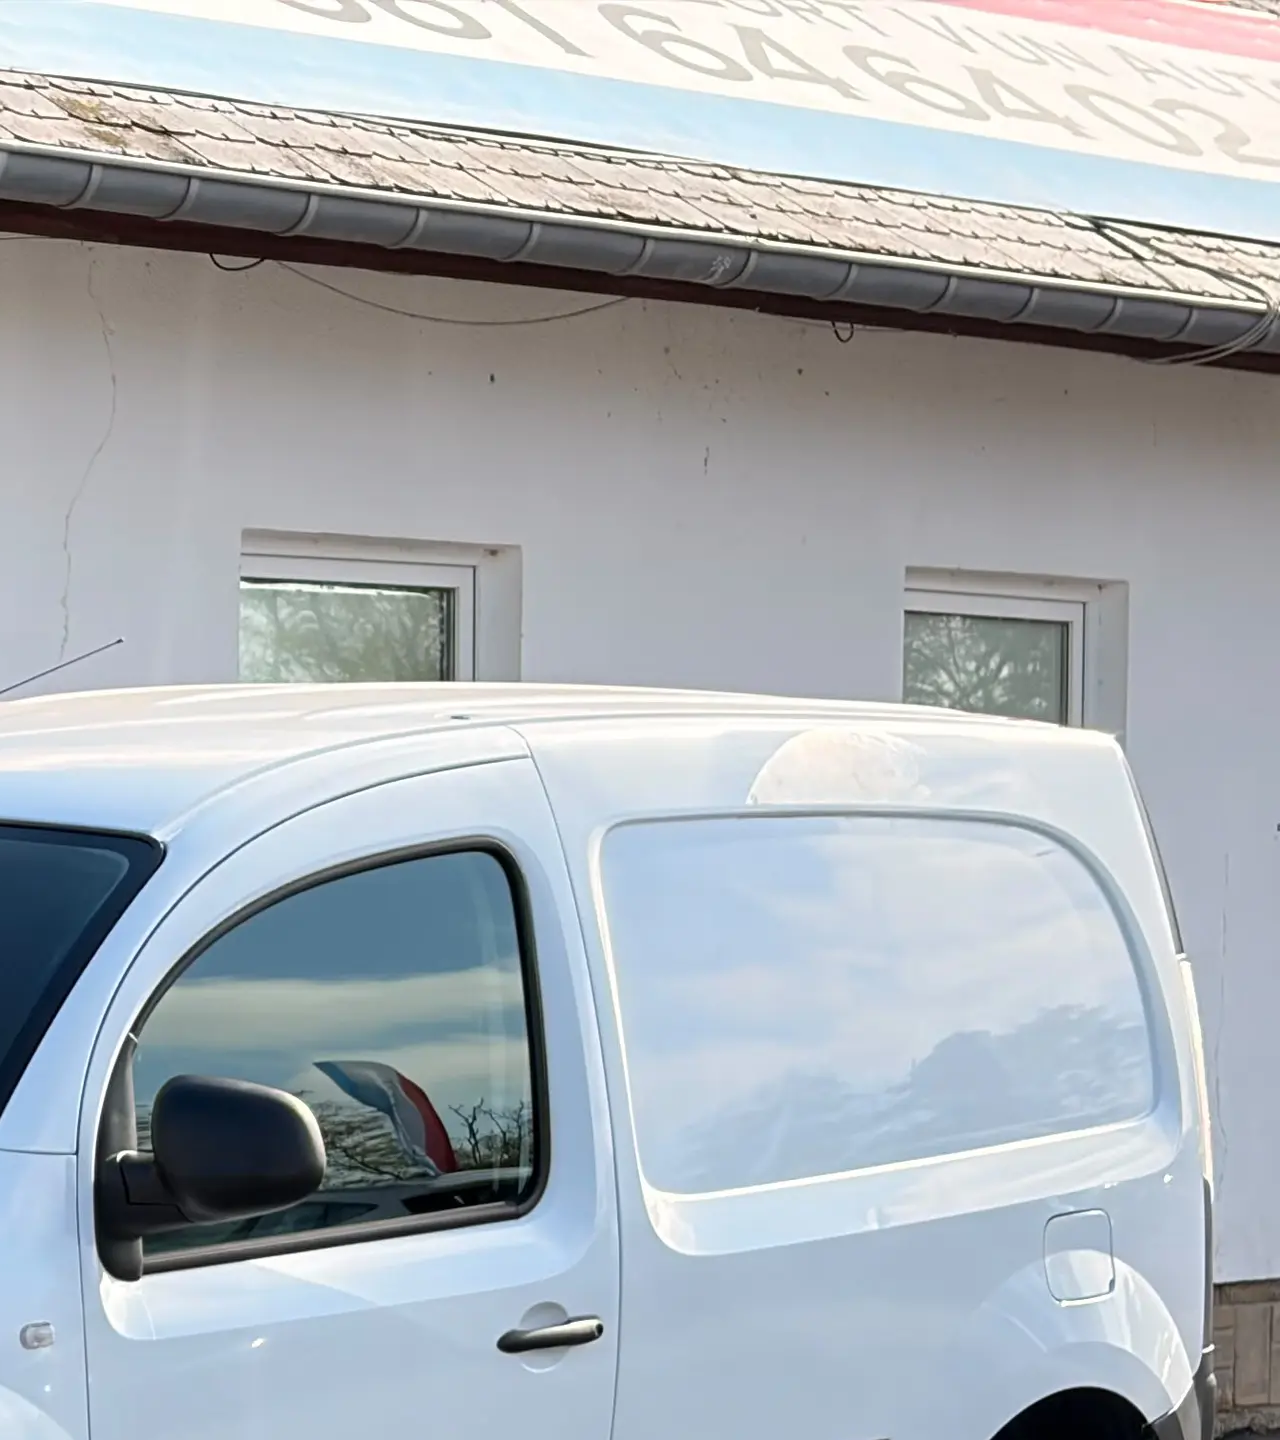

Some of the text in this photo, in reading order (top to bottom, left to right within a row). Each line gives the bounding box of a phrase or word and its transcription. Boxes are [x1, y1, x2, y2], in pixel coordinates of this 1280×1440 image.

[596, 3, 871, 102] 64
[842, 45, 1098, 140] 64
[1064, 84, 1280, 167] 02
[888, 6, 1111, 77] VUN
[1107, 44, 1280, 104] AUT
